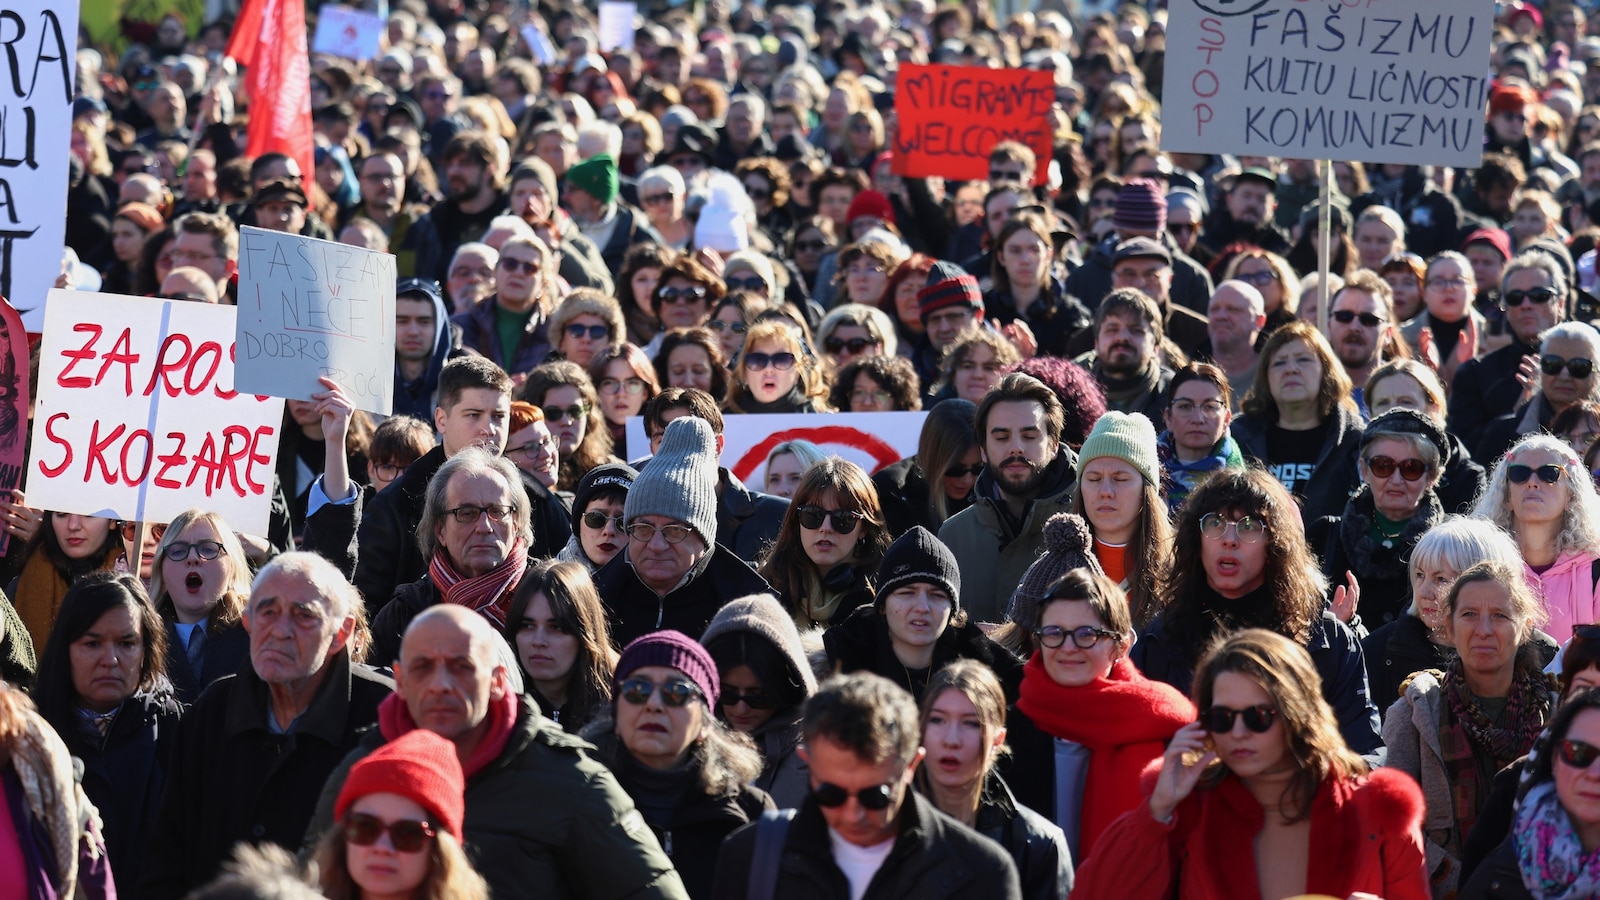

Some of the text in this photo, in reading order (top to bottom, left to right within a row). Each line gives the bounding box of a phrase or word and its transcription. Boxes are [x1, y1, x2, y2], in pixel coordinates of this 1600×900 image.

[1250, 4, 1474, 58] FAŠIZMU
[1192, 18, 1226, 137] STOP
[1244, 56, 1485, 111] KULTU LIČNOSTI
[1246, 106, 1472, 152] KOMUNIZMU
[242, 232, 394, 291] FAŠIZAM
[57, 323, 141, 397] ZA
[243, 331, 329, 362] DOBRO
